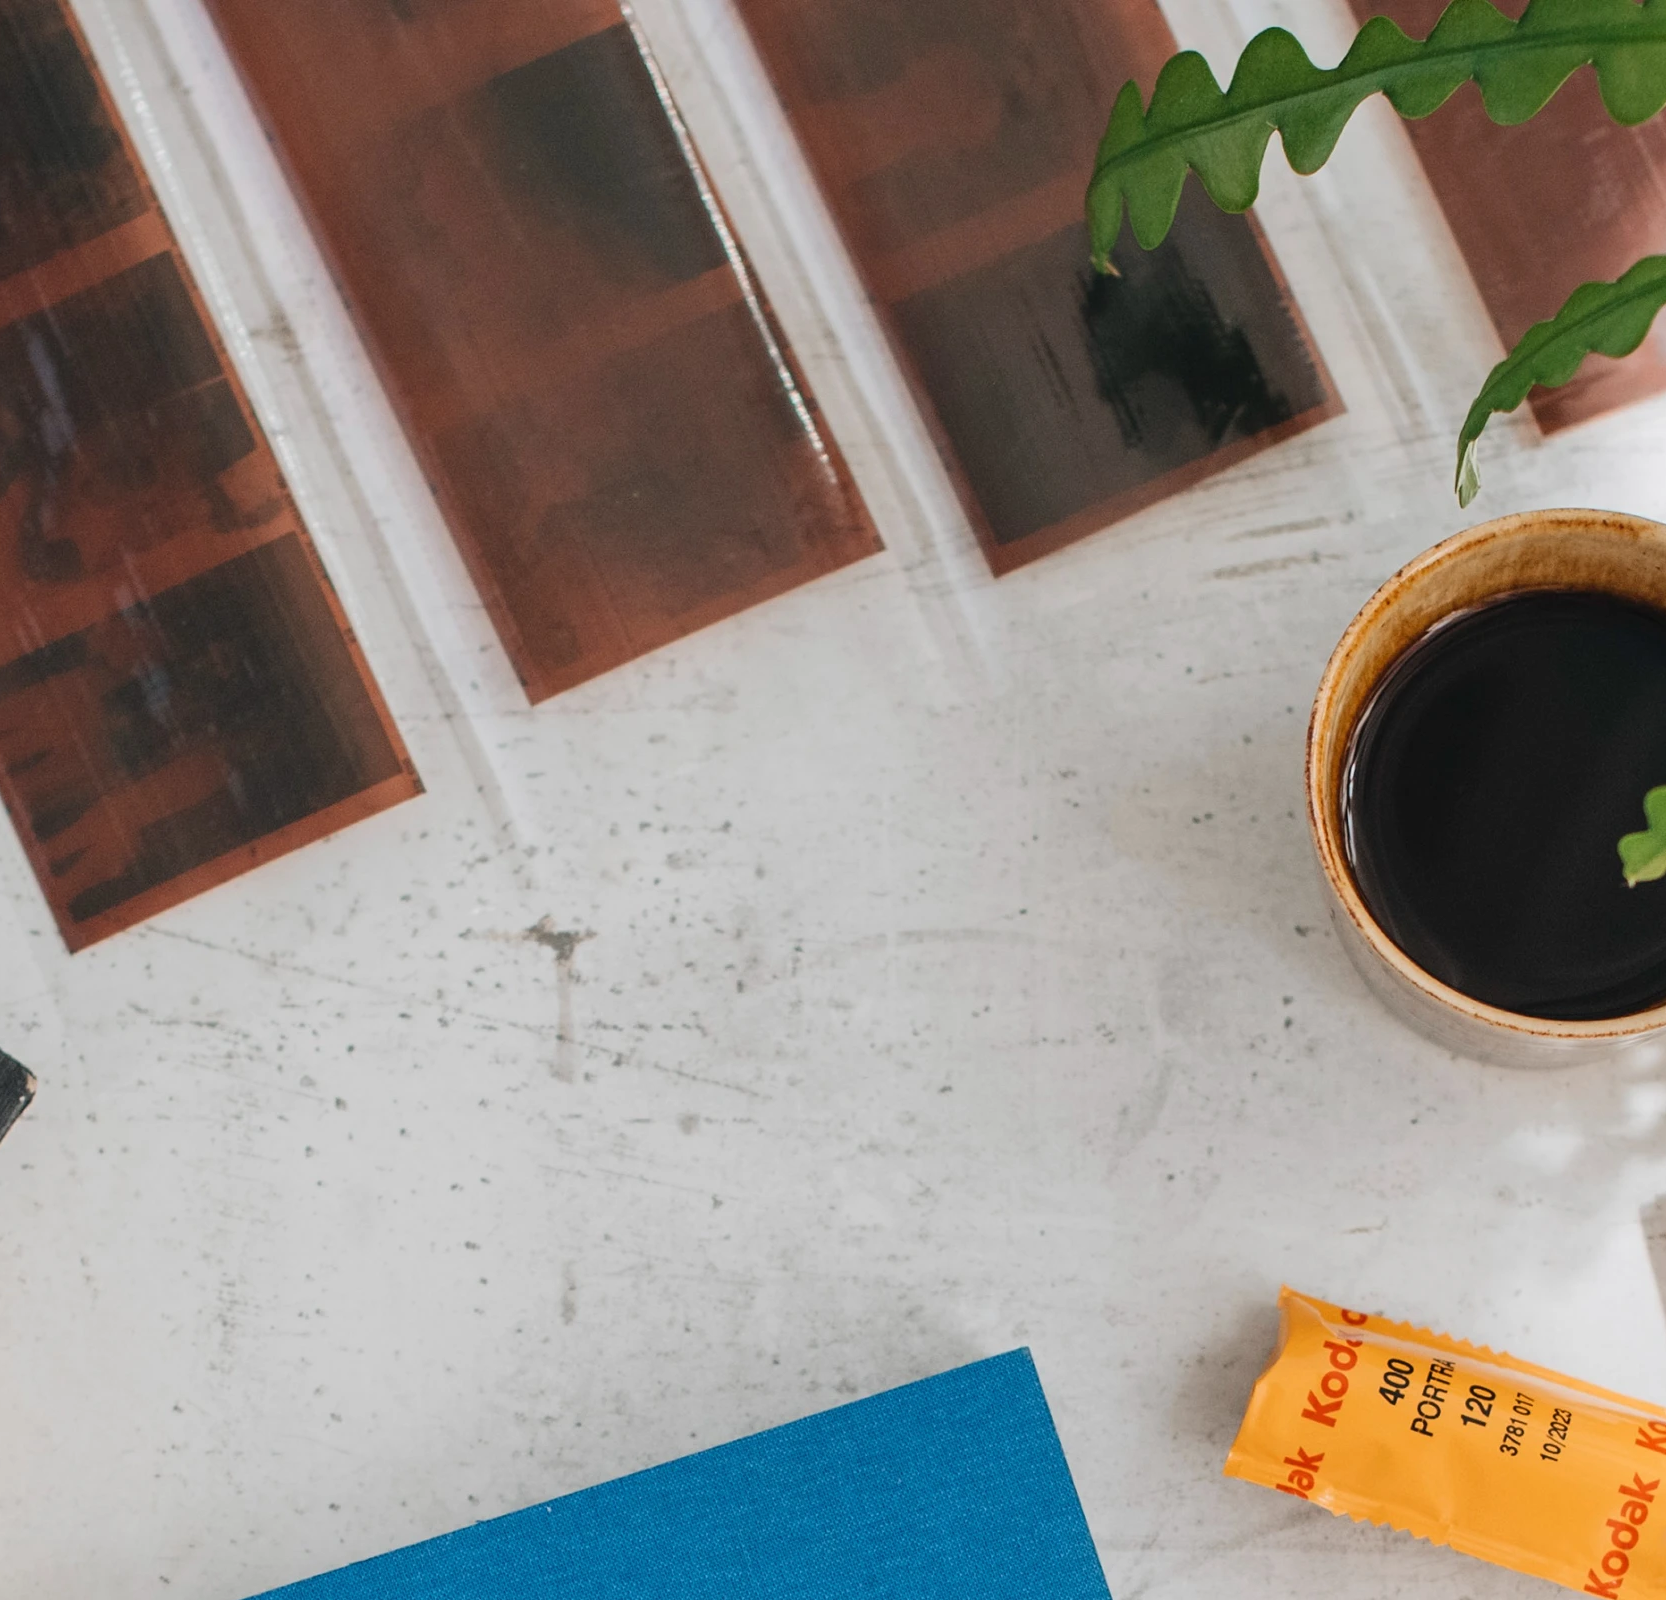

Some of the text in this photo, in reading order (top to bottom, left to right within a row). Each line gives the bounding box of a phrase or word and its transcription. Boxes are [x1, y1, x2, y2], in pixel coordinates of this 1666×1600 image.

[1379, 1358, 1414, 1406] 400
[1410, 1358, 1456, 1437] PORTRA
[1460, 1384, 1496, 1427] 120
[1499, 1392, 1534, 1456] 3781 017
[1540, 1408, 1572, 1461] 10/2023
[1583, 1472, 1661, 1600] Kodak
